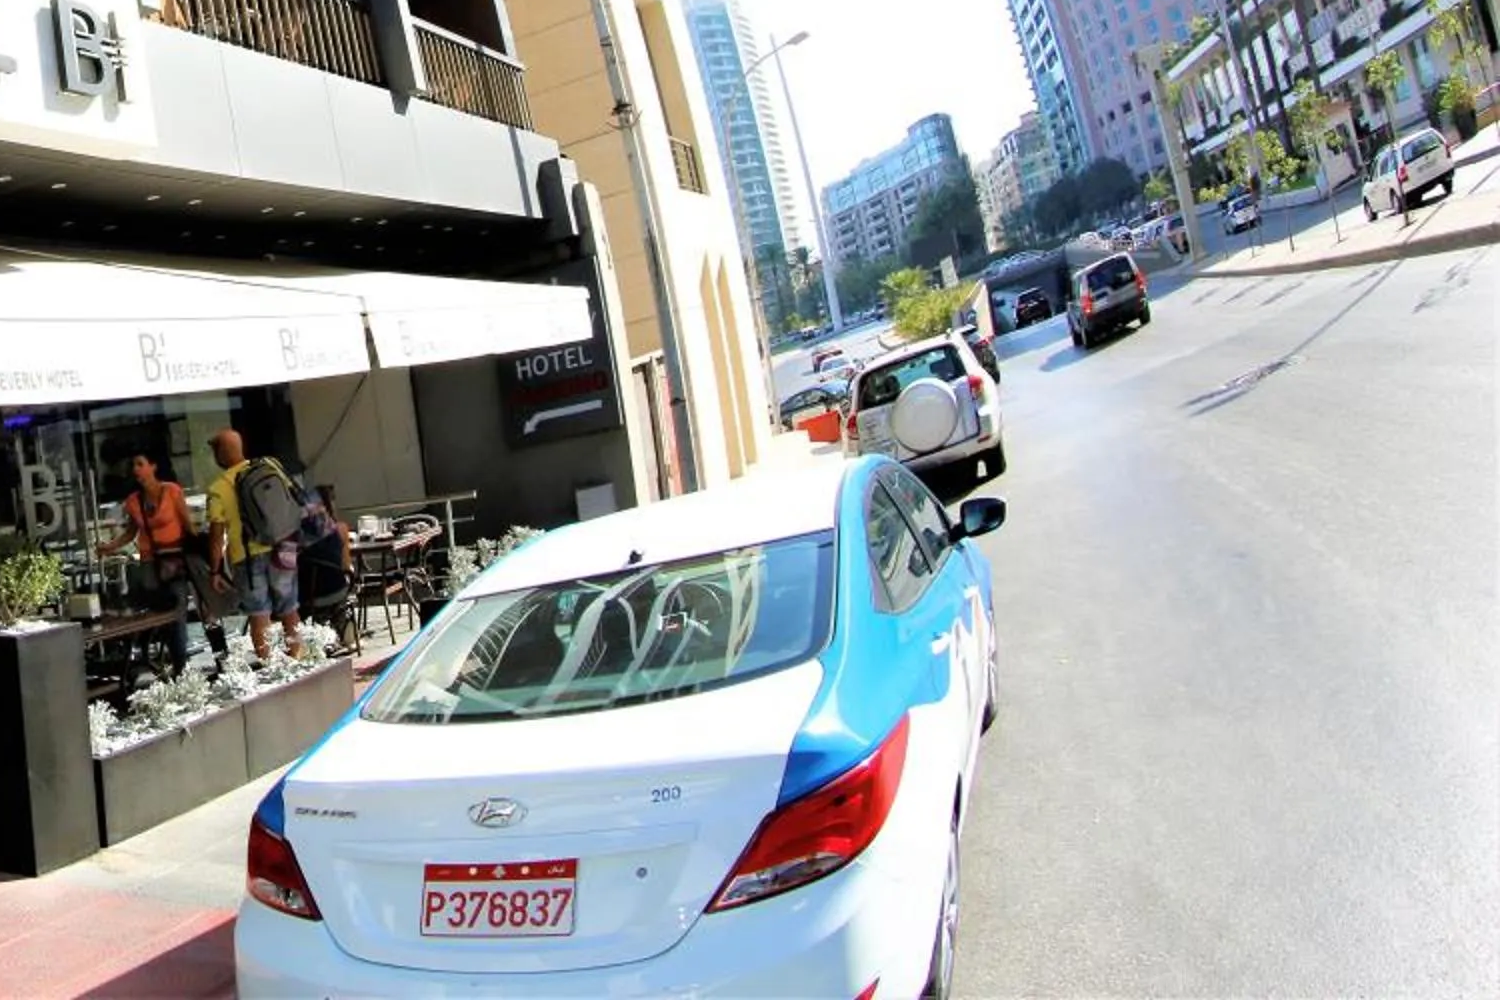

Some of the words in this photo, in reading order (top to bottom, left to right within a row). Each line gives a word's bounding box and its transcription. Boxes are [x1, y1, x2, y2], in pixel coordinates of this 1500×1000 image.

[515, 346, 593, 380] HOTEL
[651, 785, 682, 803] 200
[423, 887, 573, 930] P376837
